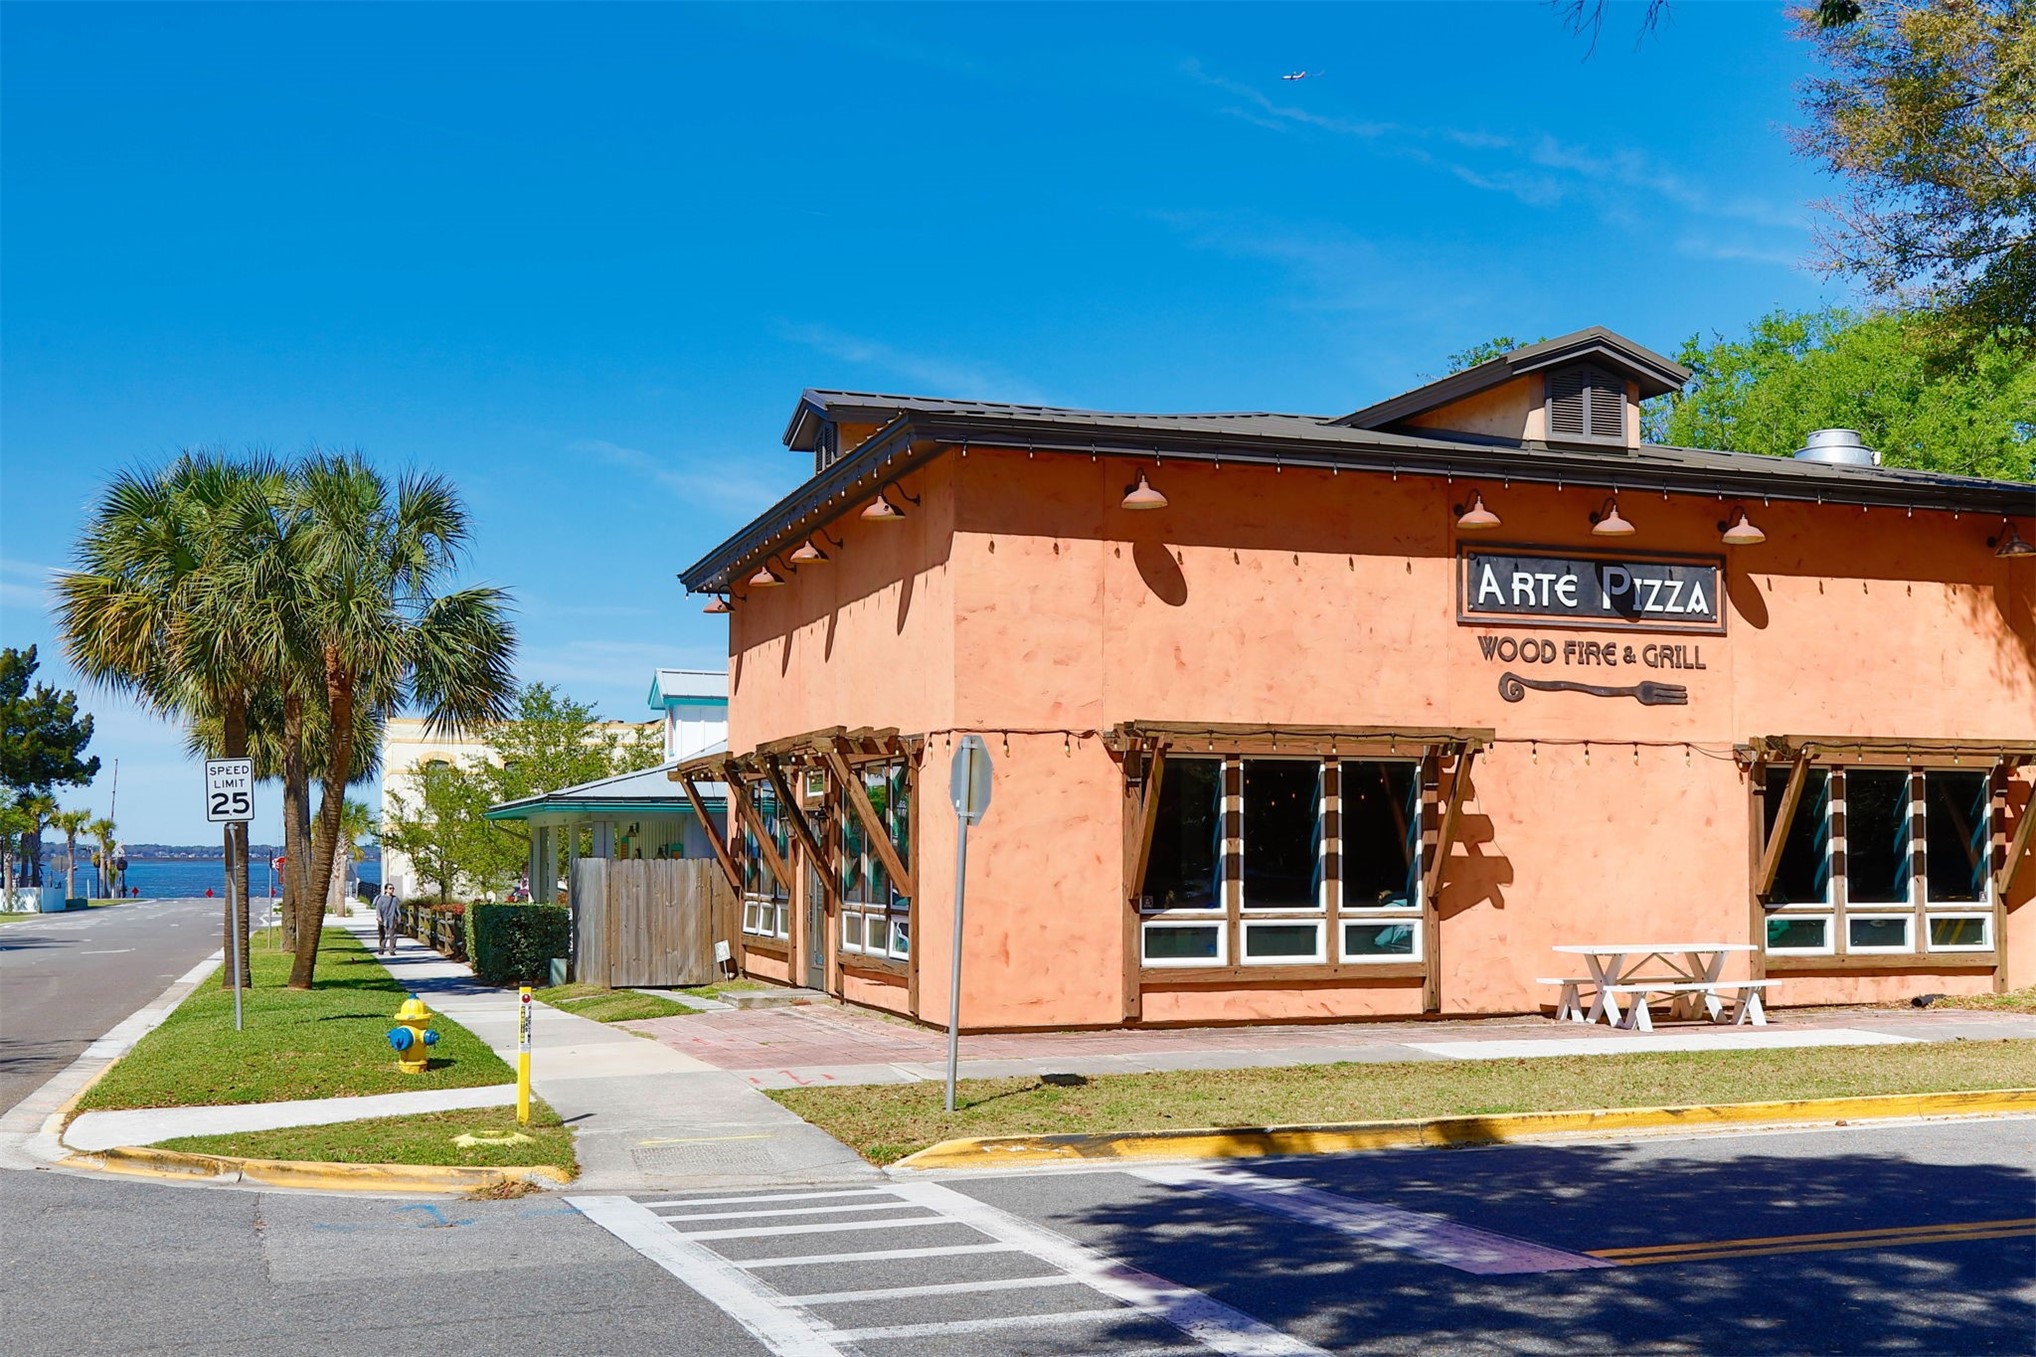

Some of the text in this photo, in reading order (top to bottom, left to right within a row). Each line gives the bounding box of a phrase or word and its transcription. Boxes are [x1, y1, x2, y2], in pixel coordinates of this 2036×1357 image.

[1602, 566, 1710, 614] PIZZA
[1477, 636, 1706, 669] WOOD FIRE & GRILL
[209, 765, 249, 776] SPEED
[214, 779, 245, 788] LIMIT
[211, 792, 250, 815] 25
